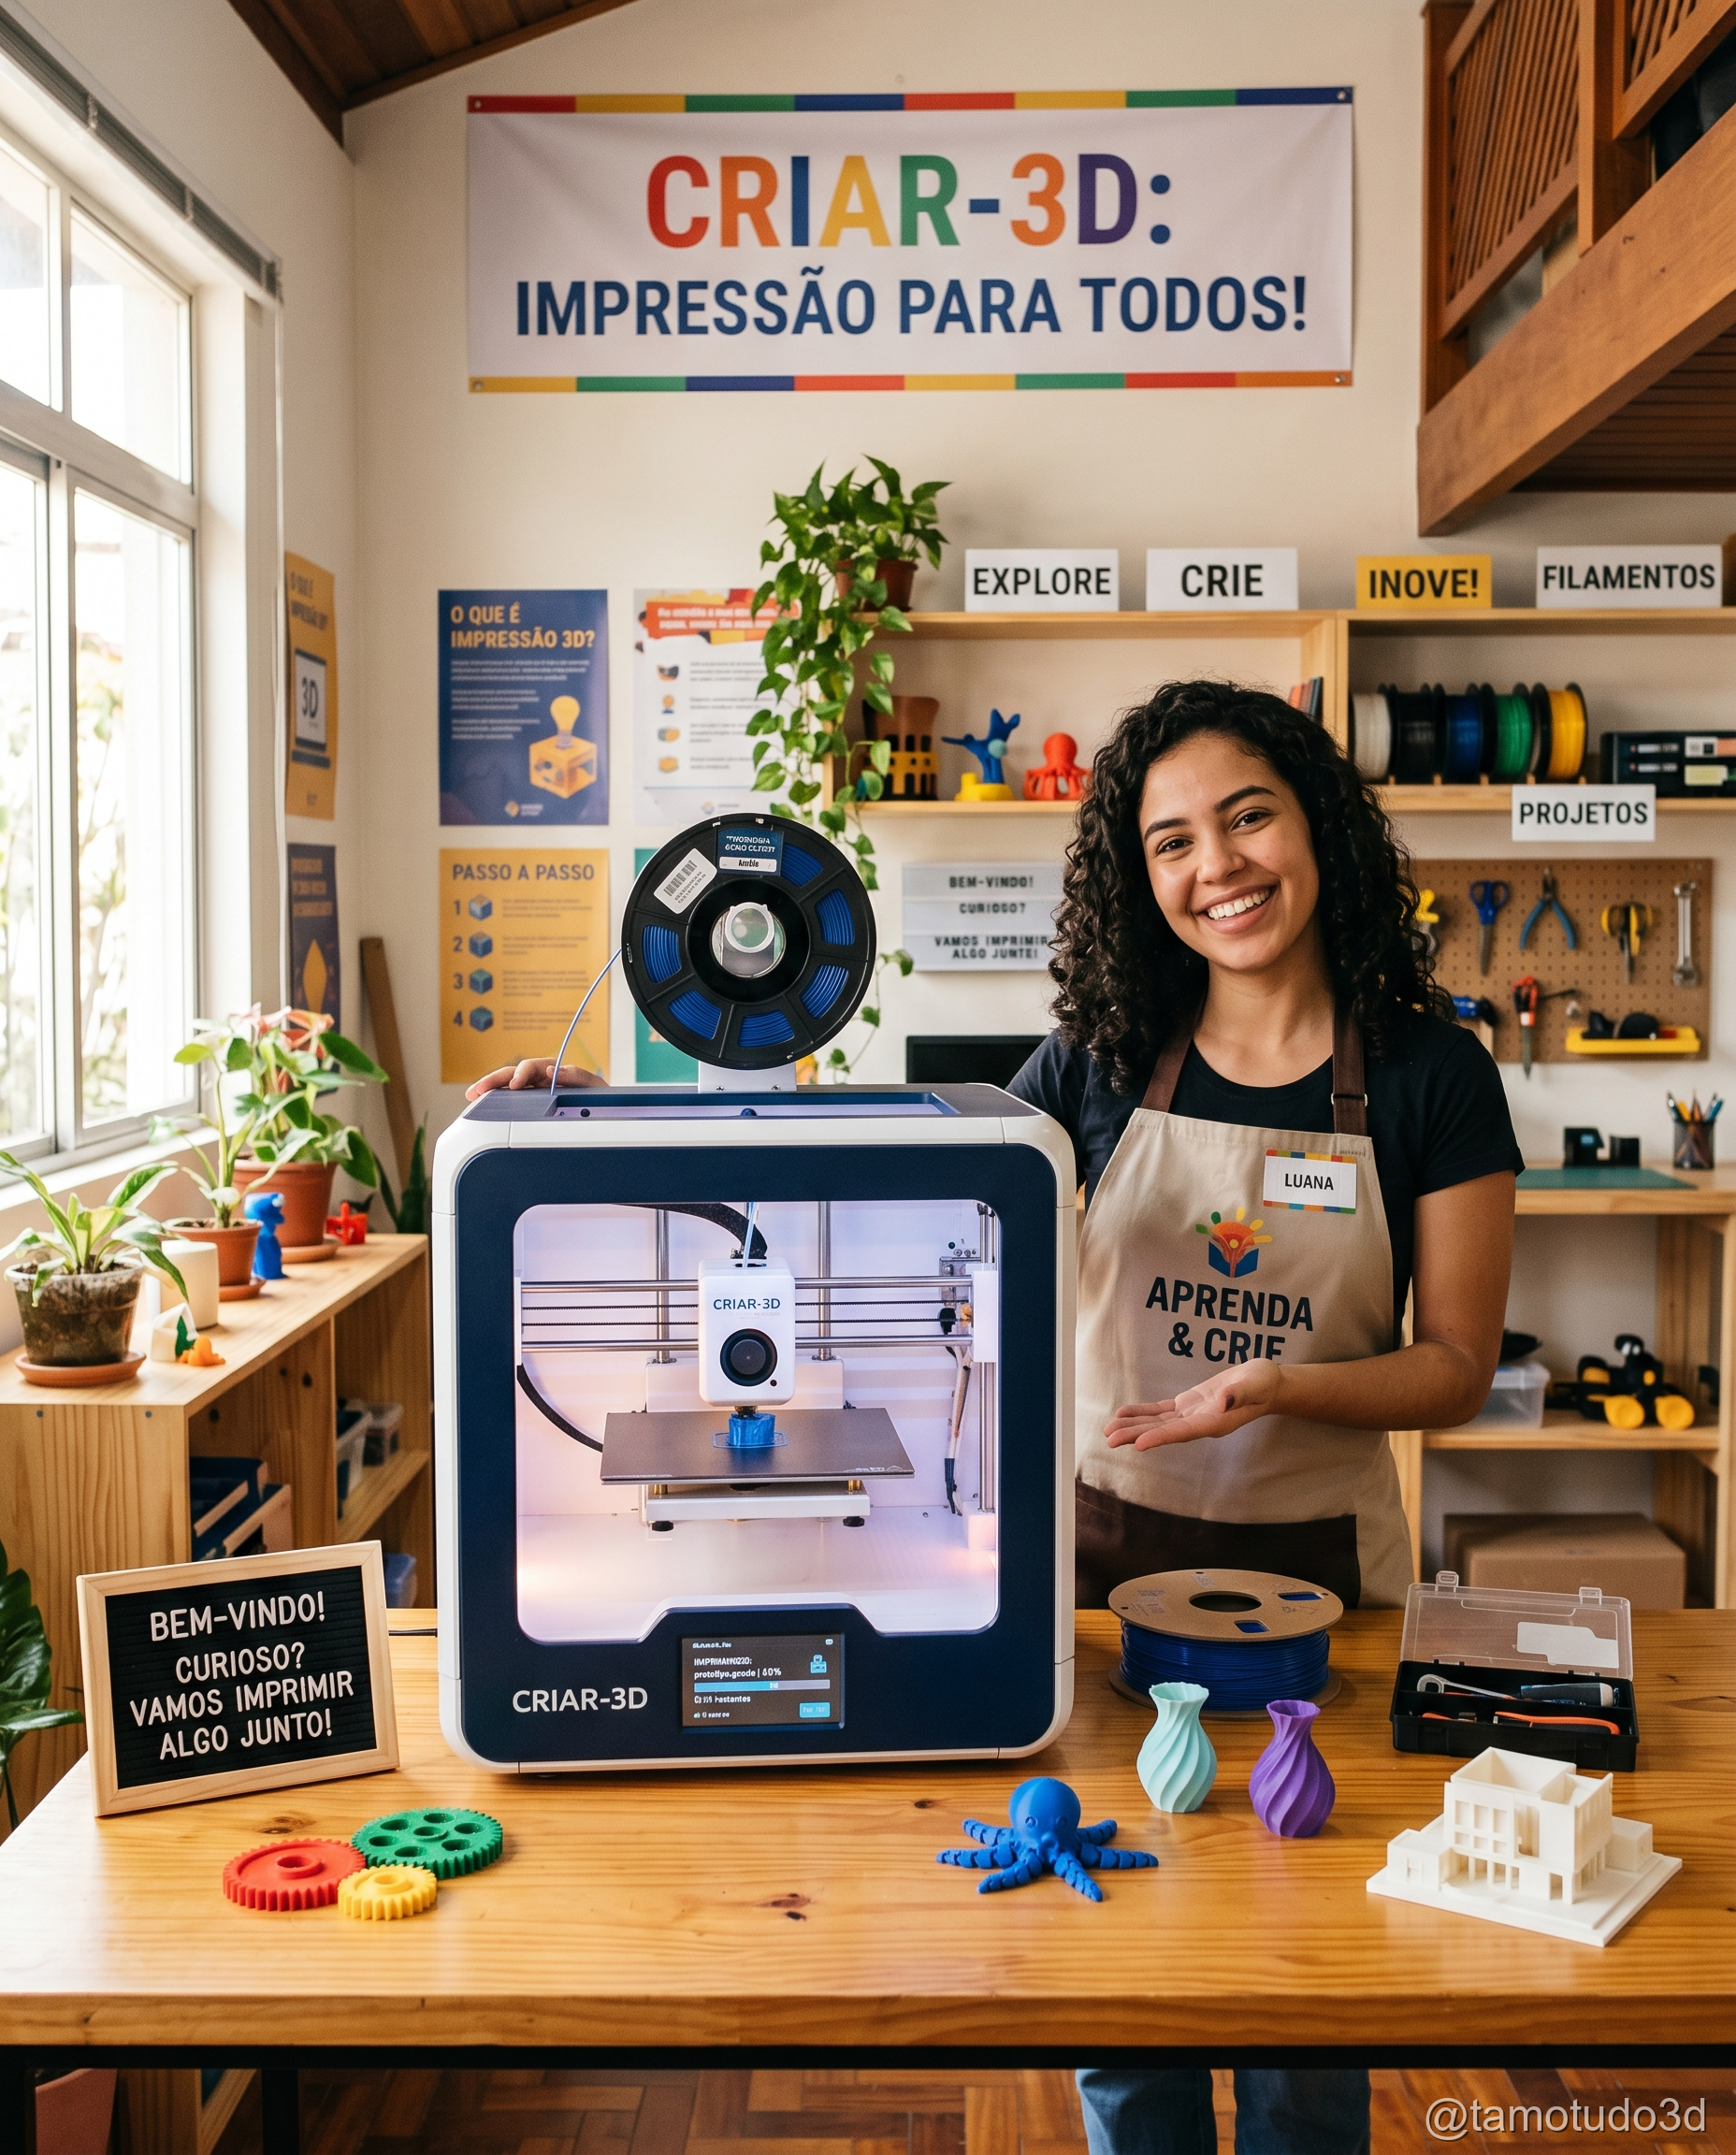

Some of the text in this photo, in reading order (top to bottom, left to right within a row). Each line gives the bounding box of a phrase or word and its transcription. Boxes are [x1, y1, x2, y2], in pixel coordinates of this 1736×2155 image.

[646, 152, 1171, 249] CRIAR-3D:
[516, 266, 1306, 336] IMPRESSÃO PARA TODOS!
[973, 567, 1111, 596] EXPLORE
[1180, 564, 1264, 598] CRIE
[1368, 568, 1480, 599] INOVE!
[1542, 564, 1716, 590] FILAMENTOS
[450, 601, 520, 626] O QUE É
[451, 626, 596, 648] IMPRESSÃO 3D?
[301, 675, 319, 719] 3D
[1520, 803, 1648, 824] PROJETOS
[452, 863, 595, 881] PASSO A PASSO
[948, 875, 1034, 889] BEM-VINDO!
[453, 899, 461, 916] 1
[453, 935, 463, 953] 2
[934, 936, 1048, 947] VAMOS IMPRIMIR
[952, 947, 987, 959] ALGO
[453, 972, 464, 990] 3
[453, 1010, 464, 1027] 4
[1284, 1173, 1334, 1191] LUANA
[713, 1298, 781, 1310] CRIAR-3D
[1145, 1276, 1313, 1332] APRENDA
[1168, 1322, 1194, 1358] &
[150, 1591, 326, 1642] BEM-VINDO!
[175, 1642, 306, 1684] CURIOSO?
[129, 1670, 354, 1727] VAMOS IMPRIMIR
[512, 1686, 648, 1714] CRIAR-3D
[159, 1708, 333, 1760] ALGO JUNTO!
